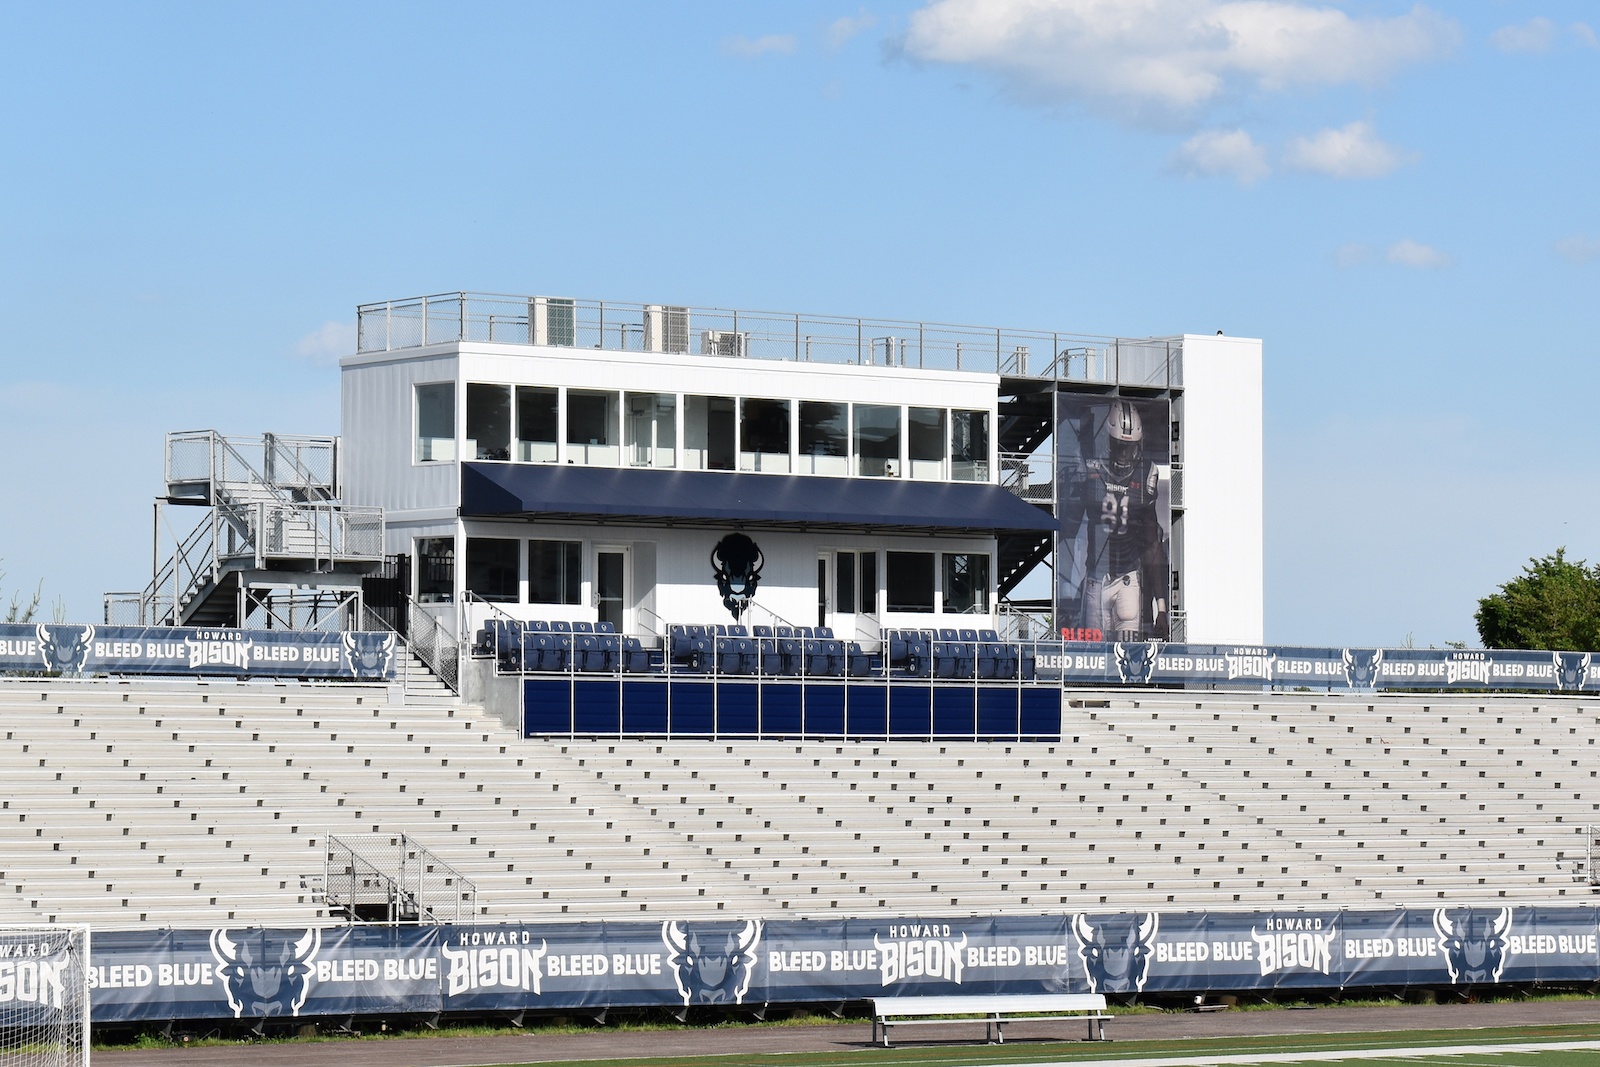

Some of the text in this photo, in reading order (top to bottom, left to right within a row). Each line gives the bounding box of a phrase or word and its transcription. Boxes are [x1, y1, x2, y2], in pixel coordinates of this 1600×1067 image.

[196, 631, 242, 641] HOWARD
[1061, 628, 1103, 642] BLEED
[0, 640, 36, 656] BLUE
[94, 642, 185, 659] BLEED BLUE
[184, 635, 253, 670] BISON
[253, 646, 340, 662] BLEED BLUE
[1233, 648, 1268, 656] HOWARD
[1036, 655, 1105, 670] BLEED BLUE
[1158, 657, 1224, 672] BLEED BLUE
[1225, 651, 1276, 681] BISON
[1277, 660, 1342, 675] BLEED BLUE
[1382, 663, 1445, 676] BLEED BLUE
[1445, 656, 1493, 685] BISON
[1493, 663, 1553, 678] BLEED BLUE
[889, 924, 951, 938] HOWARD
[1266, 918, 1322, 931] HOWARD
[460, 931, 530, 946] HOWARD
[1345, 937, 1437, 959] BLEED BLUE
[1510, 934, 1597, 955] BLEED BLUE
[873, 931, 968, 988] BISON
[967, 945, 1067, 968] BLEED BLUE
[1157, 941, 1253, 963] BLEED BLUE
[1251, 924, 1336, 977] BISON
[317, 958, 437, 982] BLEED BLUE
[442, 938, 547, 997] BISON
[547, 953, 661, 977] BLEED BLUE
[769, 949, 877, 972] BLEED BLUE
[89, 963, 213, 988] BLEED BLUE
